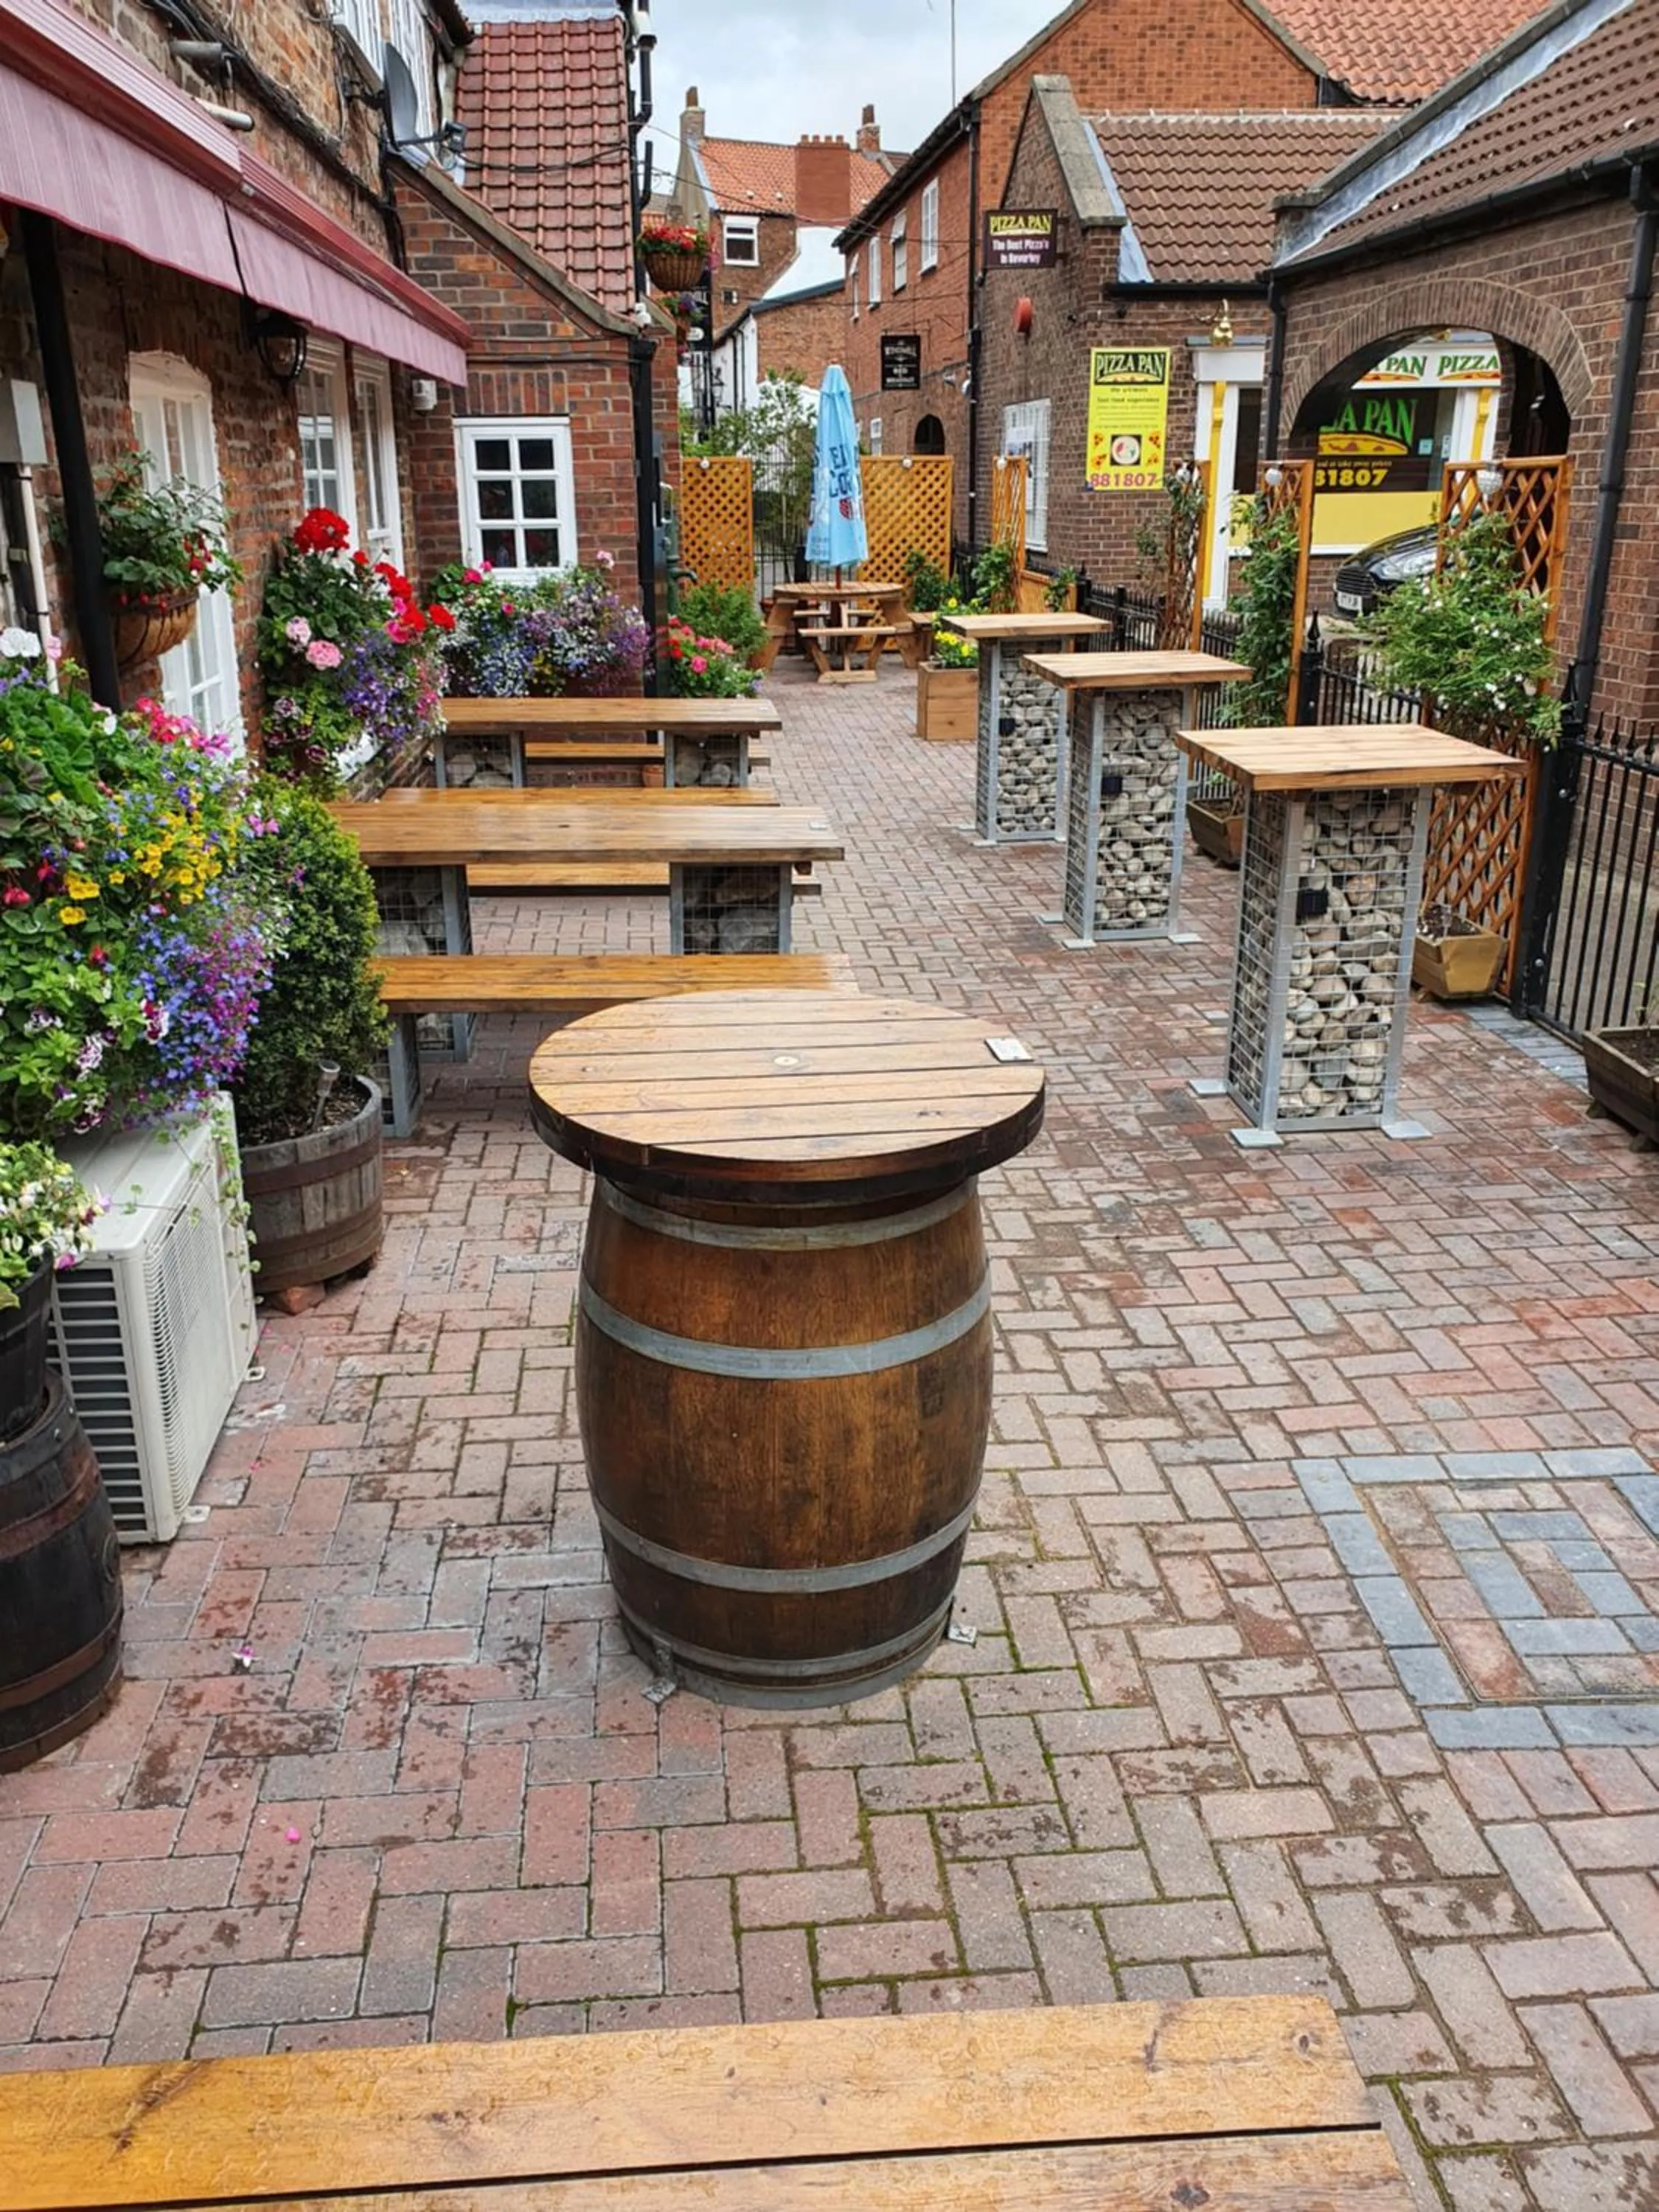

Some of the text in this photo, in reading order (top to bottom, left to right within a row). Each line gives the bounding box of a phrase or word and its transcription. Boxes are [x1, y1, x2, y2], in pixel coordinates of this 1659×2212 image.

[990, 215, 1052, 233] PIZZA PAN
[1096, 354, 1164, 379] PIZZA PAN
[1385, 356, 1427, 378] PAN
[1437, 354, 1500, 377] PIZZA
[1364, 397, 1418, 448] PAN
[1091, 473, 1156, 487] 881807
